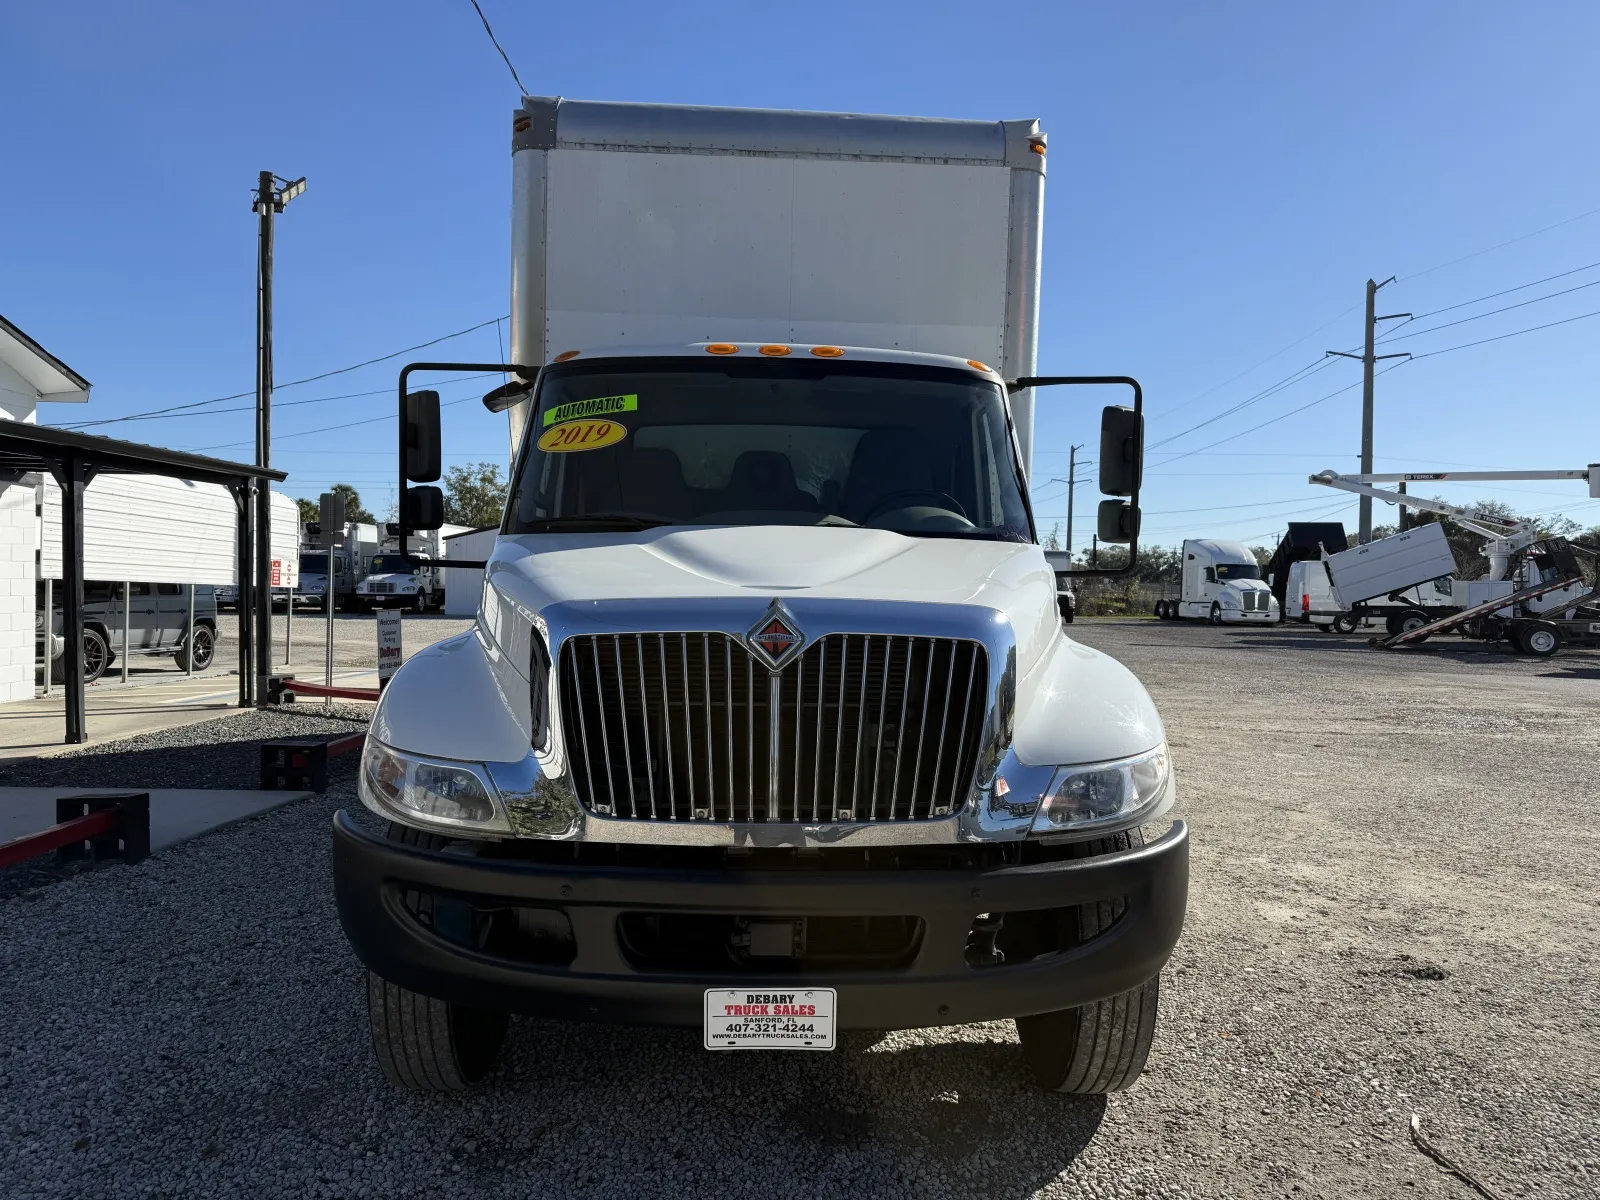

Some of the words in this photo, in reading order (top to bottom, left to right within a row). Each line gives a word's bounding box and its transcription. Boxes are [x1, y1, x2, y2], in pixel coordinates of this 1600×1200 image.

[554, 397, 625, 421] AUTOMATIC
[548, 423, 612, 448] 2019
[1483, 515, 1505, 525] TEREX
[379, 618, 399, 626] Welcome!
[380, 646, 401, 659] DeBary
[746, 994, 795, 1004] DEBARY
[725, 1005, 769, 1016] TRUCK
[774, 1005, 816, 1016] SALES
[726, 1023, 815, 1033] 407-321-4244
